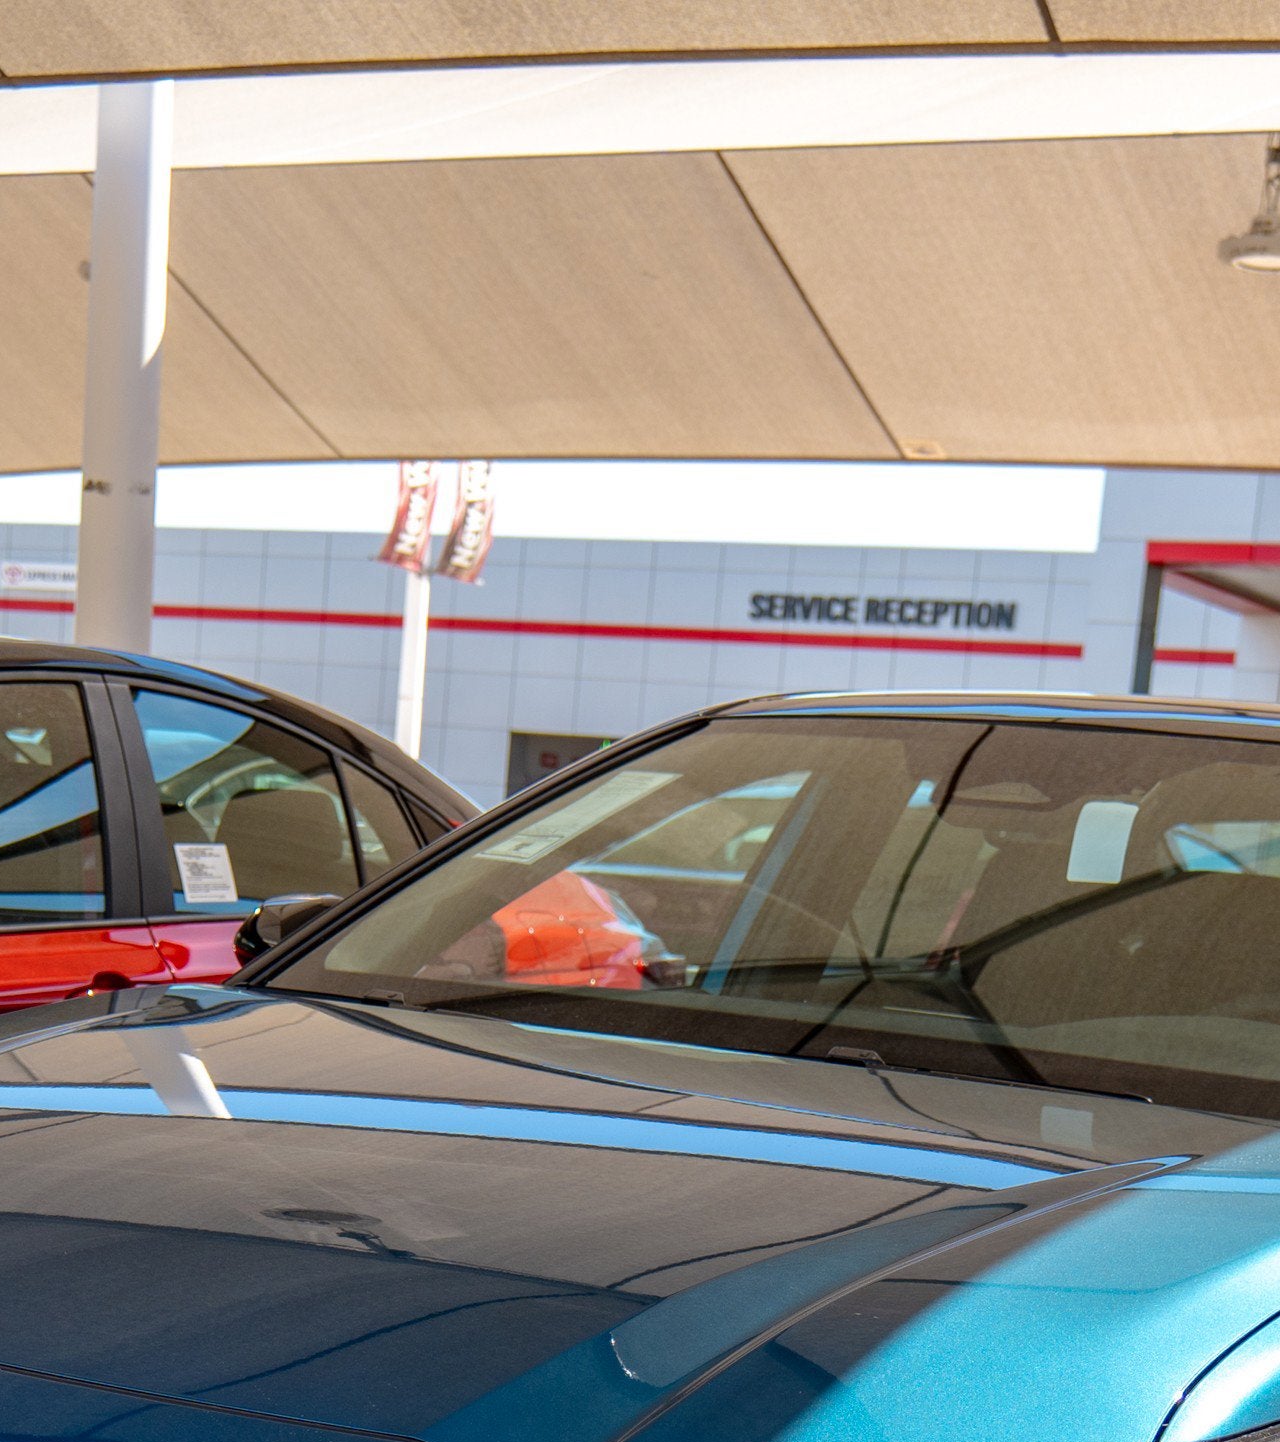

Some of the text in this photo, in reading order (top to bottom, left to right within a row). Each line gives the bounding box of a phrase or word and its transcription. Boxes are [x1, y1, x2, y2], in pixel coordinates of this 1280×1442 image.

[393, 490, 427, 556] New
[450, 506, 486, 570] New
[750, 594, 1017, 630] SERVICE RECEPTION
